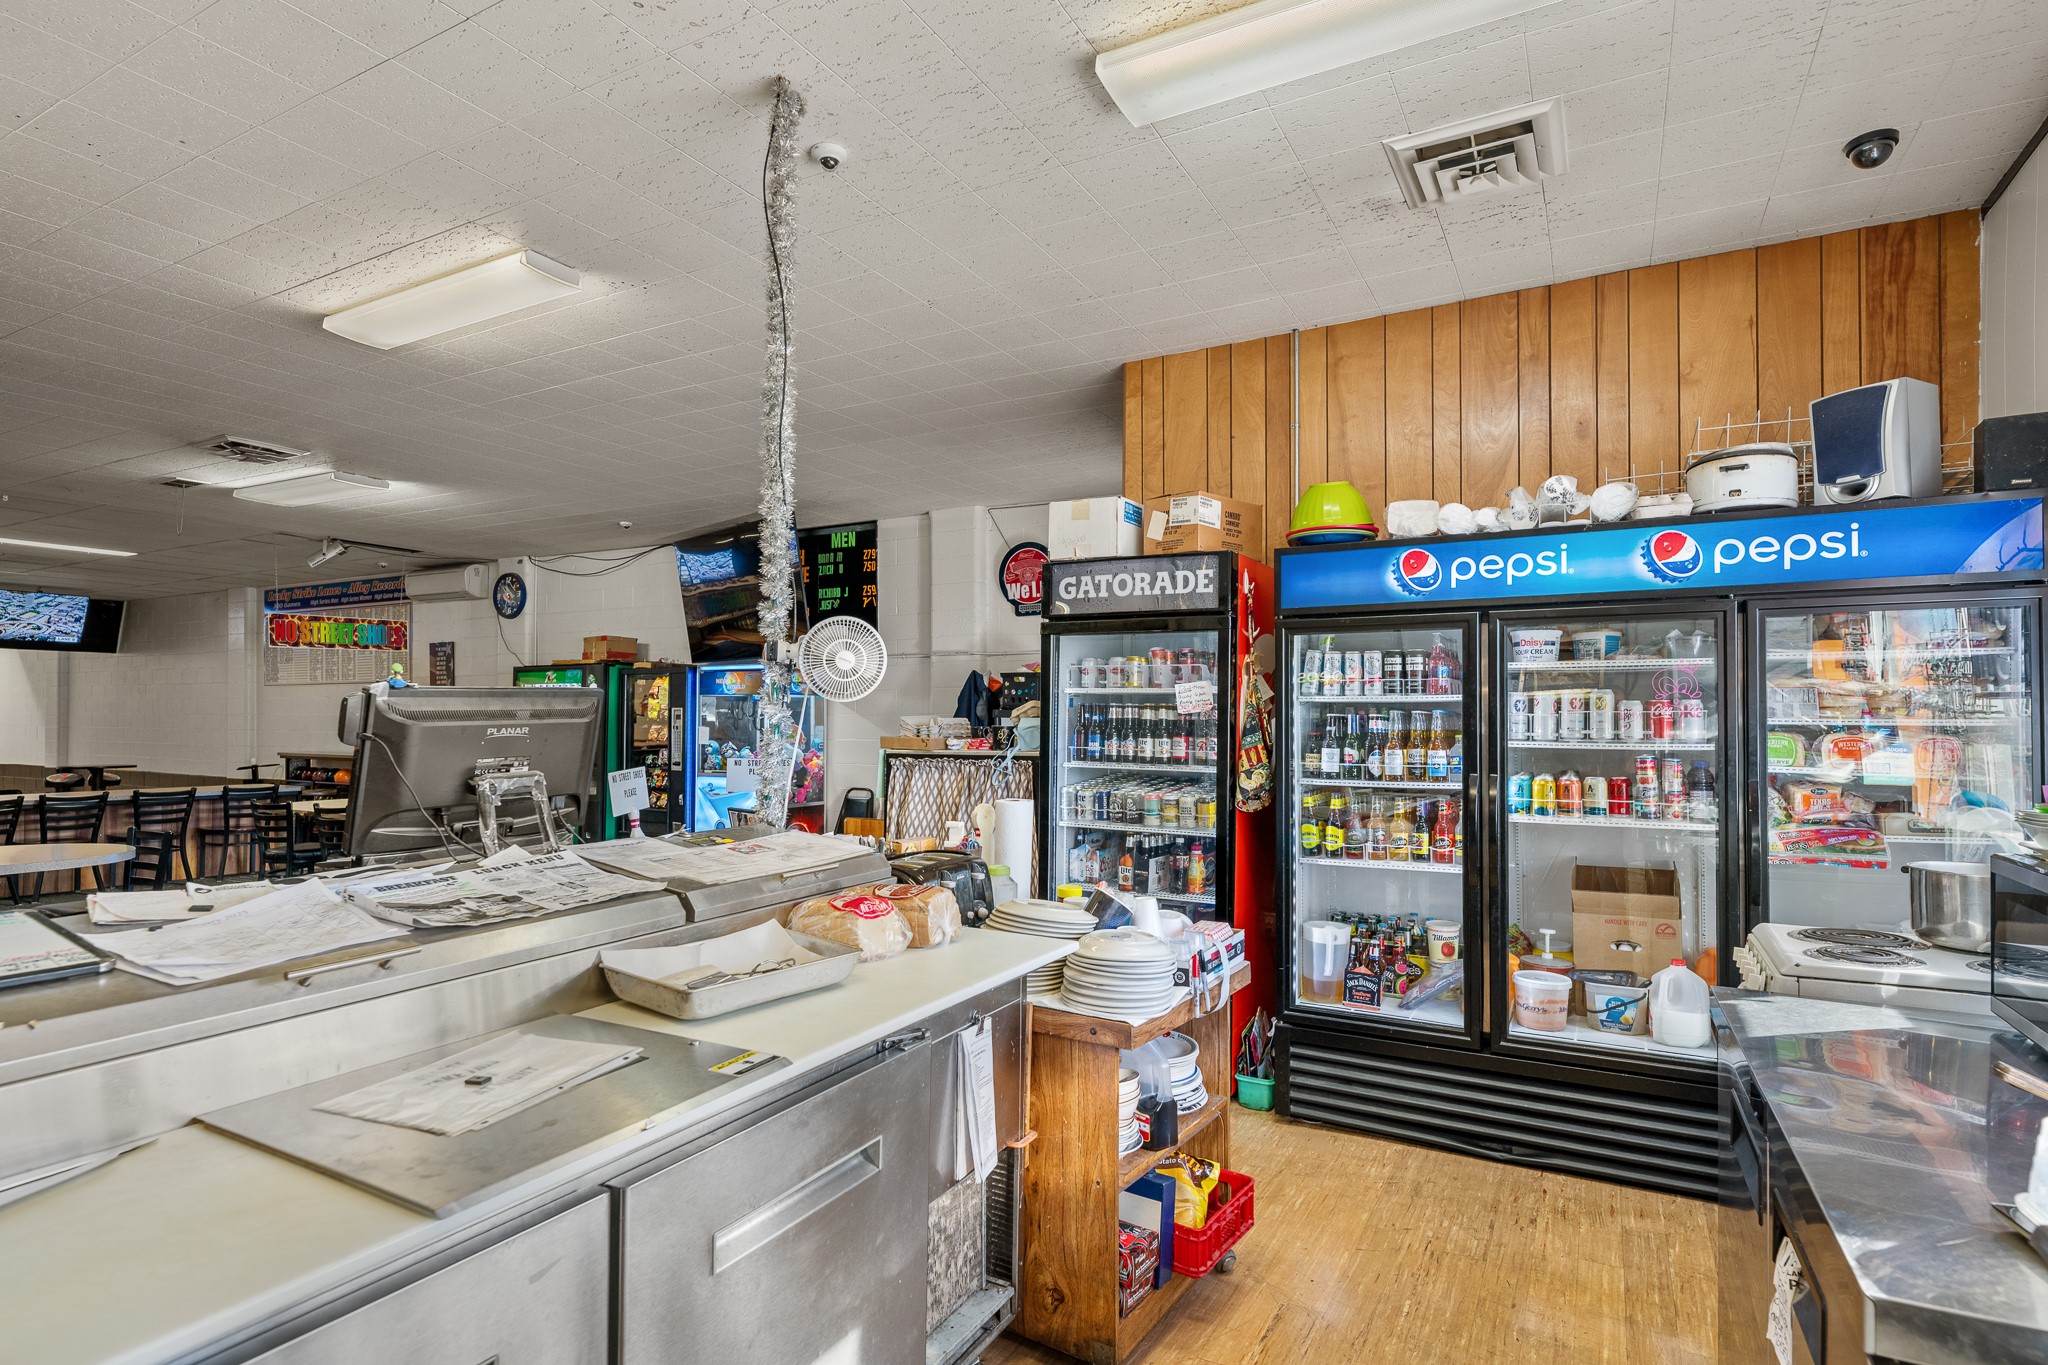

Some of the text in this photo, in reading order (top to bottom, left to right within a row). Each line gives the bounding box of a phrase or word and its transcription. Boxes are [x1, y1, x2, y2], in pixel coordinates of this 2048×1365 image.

[831, 531, 856, 548] MEN
[863, 549, 876, 560] 279
[1714, 523, 1860, 574] pepsi
[863, 561, 876, 572] 750
[1450, 543, 1569, 588] pepsi
[292, 587, 317, 599] Strike
[317, 585, 342, 596] Lanes
[347, 581, 370, 594] Alley
[371, 578, 405, 591] Records
[863, 585, 877, 596] 259
[1006, 582, 1030, 599] We
[1058, 568, 1214, 600] GATORADE
[274, 619, 403, 647] NO STREET SHOES
[1520, 639, 1544, 647] Daisy
[487, 727, 529, 735] PLANAR
[618, 773, 632, 782] STREET
[632, 769, 644, 779] SHOES
[624, 788, 637, 798] PLEASE
[472, 854, 565, 875] LUNCH MENU
[374, 875, 458, 893] BREAKFAST
[1346, 978, 1378, 992] JACK DANIEL'S
